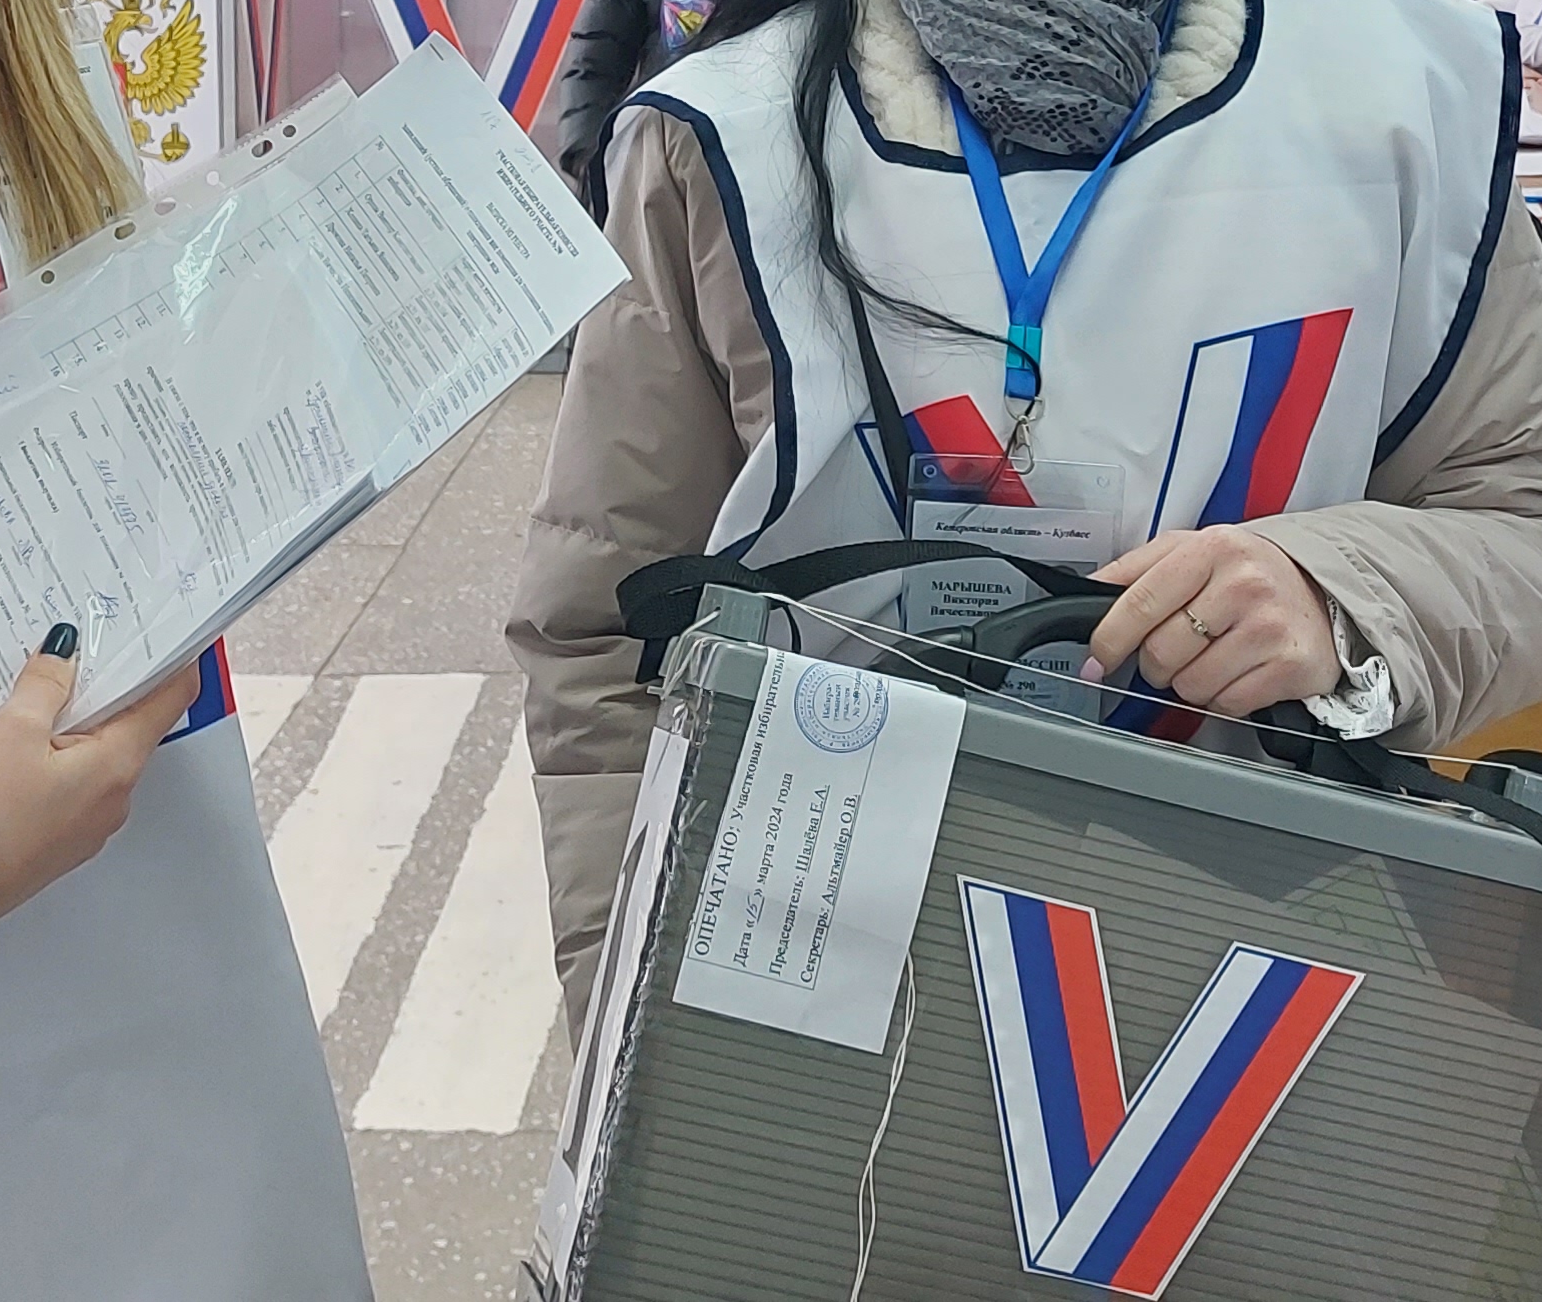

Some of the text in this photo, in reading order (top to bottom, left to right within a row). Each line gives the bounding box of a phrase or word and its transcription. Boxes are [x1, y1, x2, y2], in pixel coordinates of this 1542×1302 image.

[931, 580, 1013, 595] МАРЫШЕВА
[943, 594, 1000, 608] Виктория
[1017, 681, 1036, 691] 290
[728, 740, 764, 822] Участковая
[776, 771, 795, 805] года
[763, 805, 786, 842] 2024
[754, 842, 777, 885] марта
[799, 906, 833, 984] Секретарь:
[837, 790, 859, 824] О.В.
[766, 873, 810, 977] Председатель:
[732, 930, 755, 967] Дата
